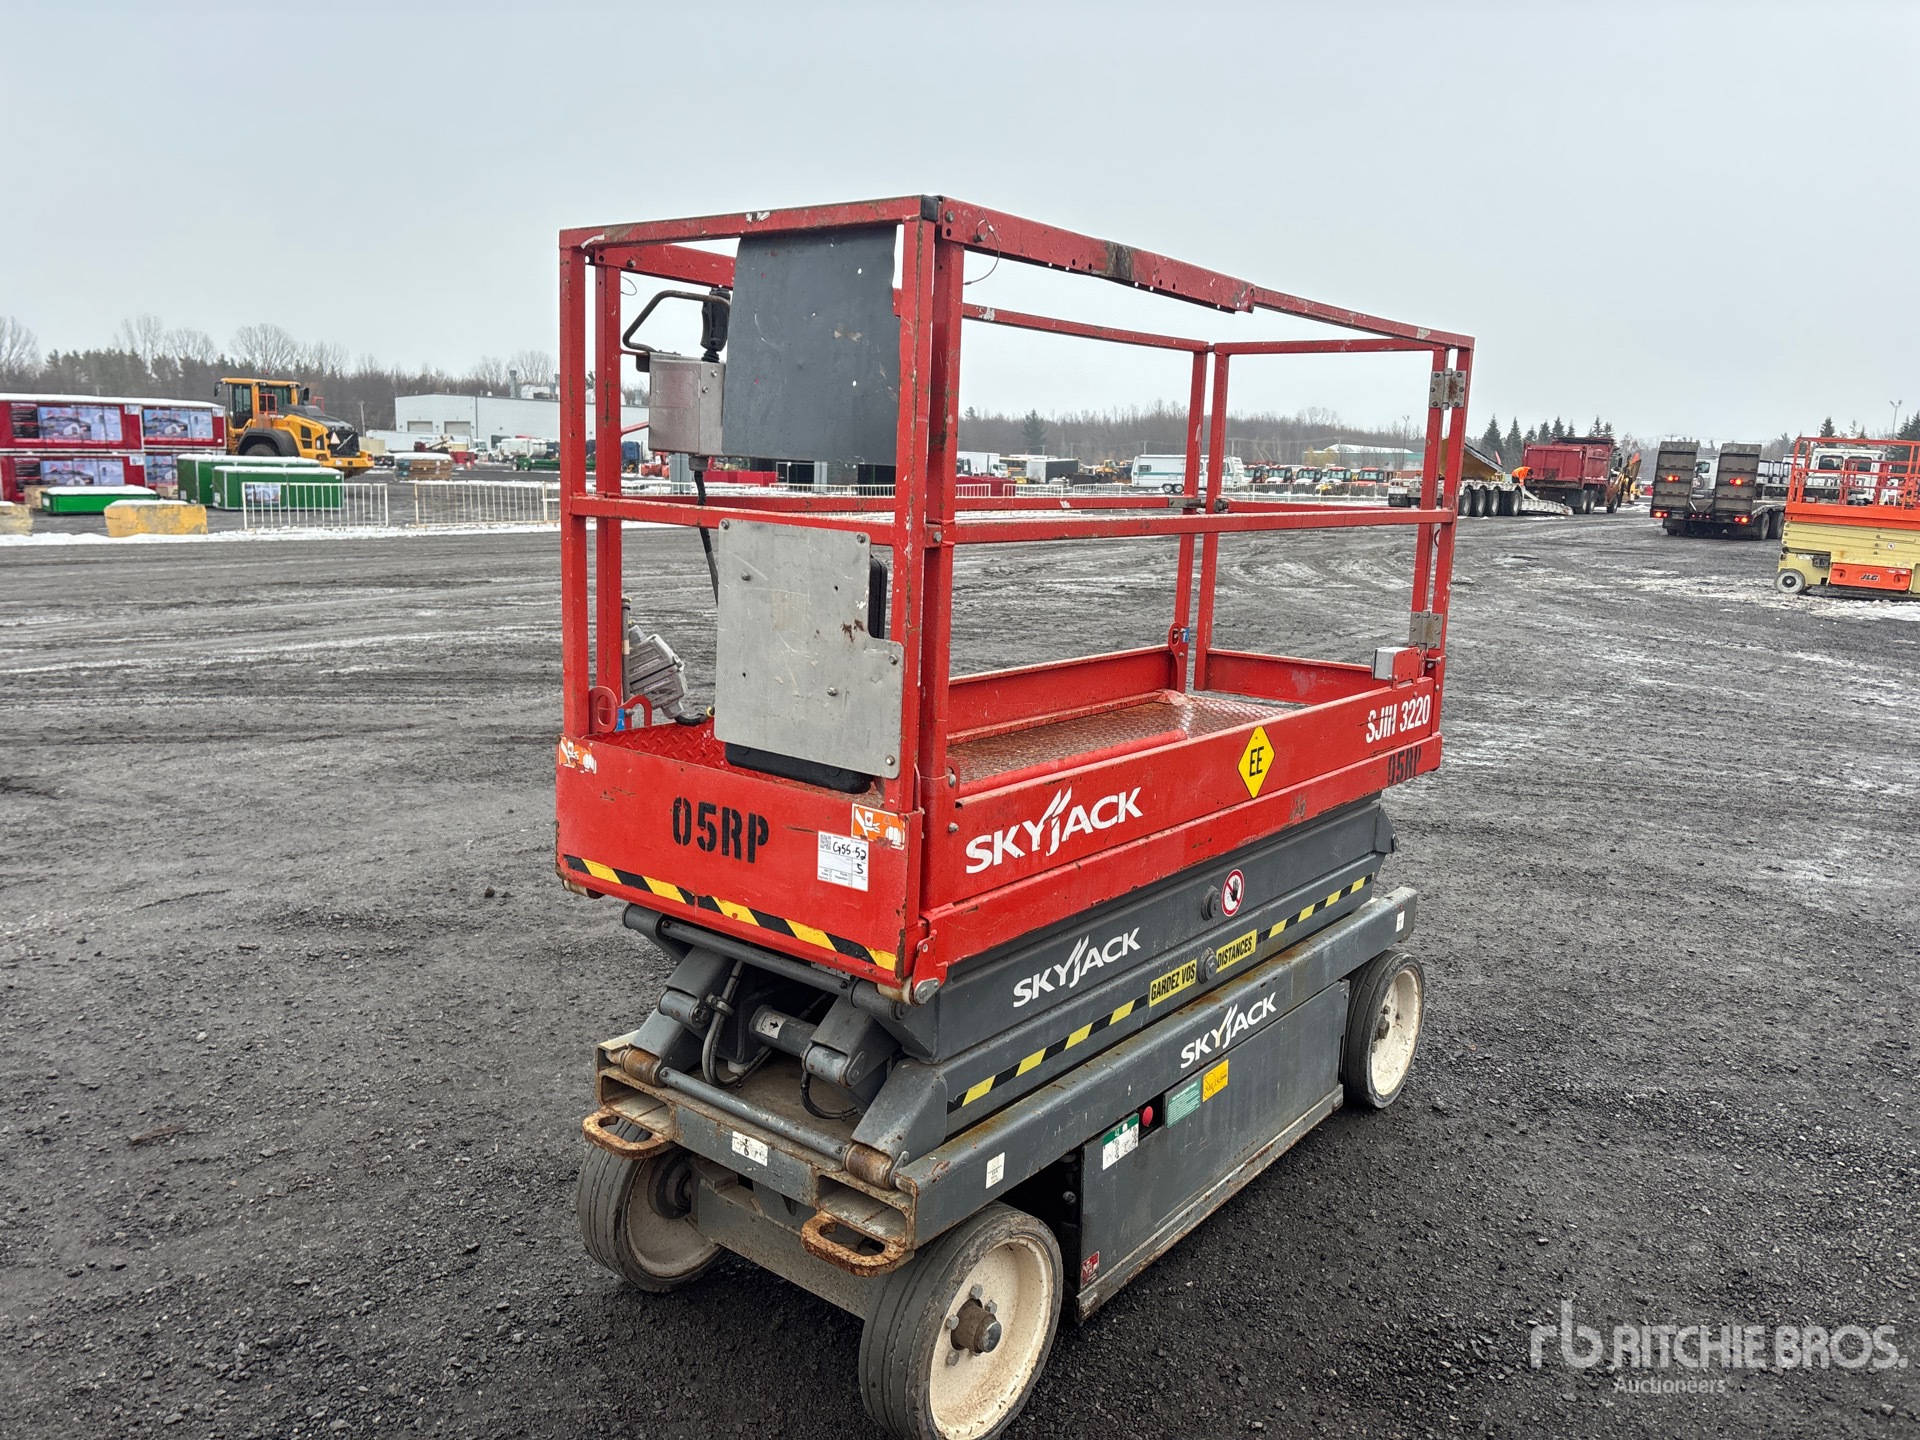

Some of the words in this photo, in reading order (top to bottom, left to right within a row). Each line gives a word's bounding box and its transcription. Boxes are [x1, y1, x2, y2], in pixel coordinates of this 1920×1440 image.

[1860, 573, 1879, 581] JLG
[1399, 694, 1431, 732] 3220
[1249, 744, 1264, 778] EE
[672, 796, 769, 864] 05RP
[965, 786, 1143, 874] SKYJACK
[1013, 926, 1142, 1008] SKYJACK
[1150, 970, 1180, 1001] GARDEZ
[1181, 963, 1196, 985] VOS
[1217, 935, 1253, 969] DISTANCES
[1180, 992, 1278, 1069] SKYJACK
